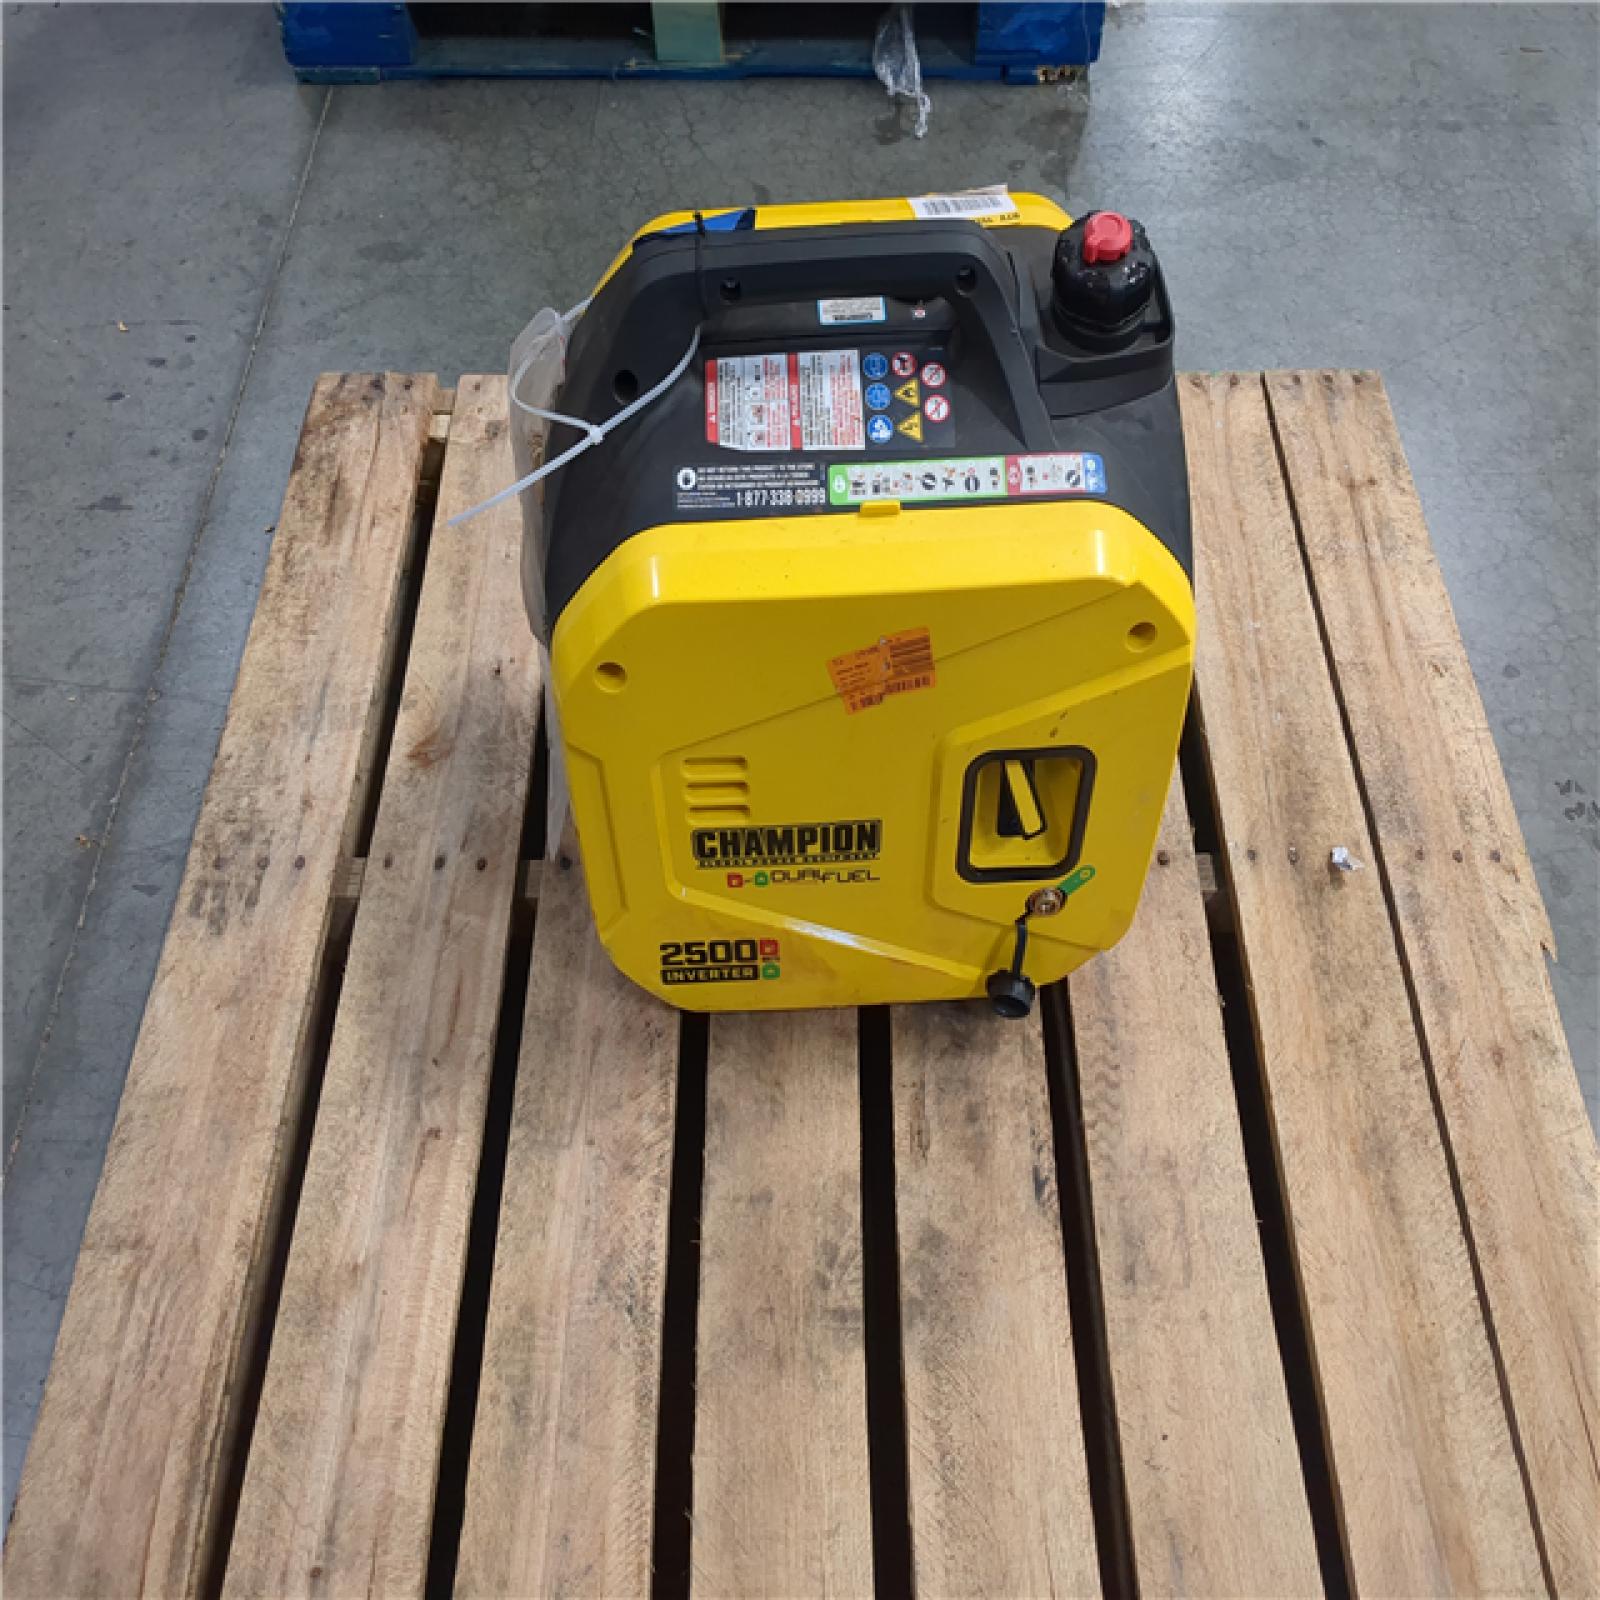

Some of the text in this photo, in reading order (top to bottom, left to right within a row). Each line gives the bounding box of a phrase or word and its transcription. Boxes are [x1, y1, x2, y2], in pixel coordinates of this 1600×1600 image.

[694, 822, 879, 859] CHAMPION
[659, 939, 758, 966] 2500
[664, 966, 756, 982] INVERTER
